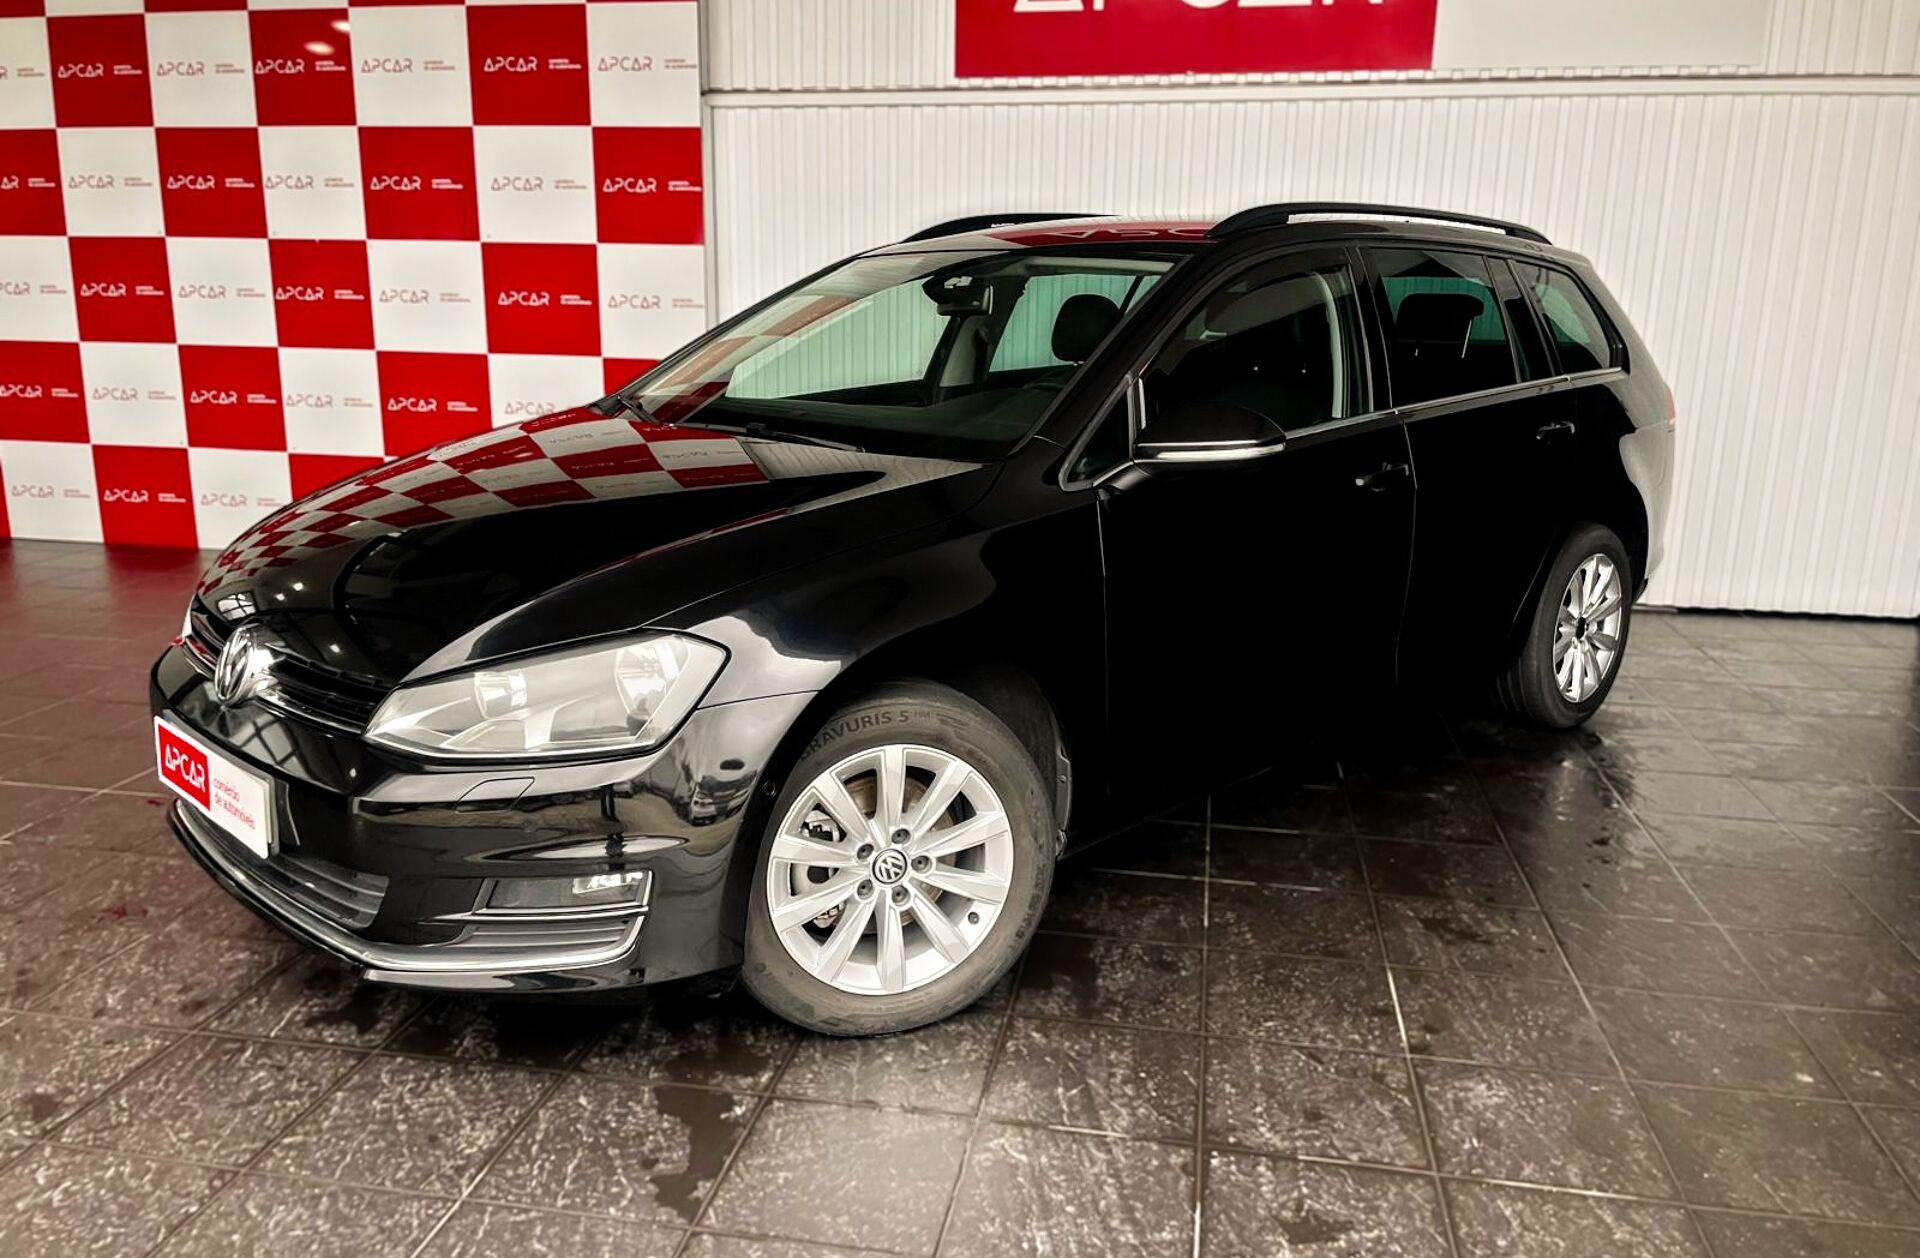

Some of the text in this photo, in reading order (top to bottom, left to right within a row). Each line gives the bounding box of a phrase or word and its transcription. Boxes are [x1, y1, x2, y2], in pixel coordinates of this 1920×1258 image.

[58, 63, 104, 78] APCAR
[156, 61, 205, 76] APCAR
[255, 58, 304, 74] APCAR
[361, 57, 413, 74] APCAR
[484, 56, 537, 72] APCAR
[597, 56, 652, 72] APCAR
[69, 174, 114, 188] APCAR
[167, 174, 215, 189] APCAR
[265, 175, 313, 189] APCAR
[370, 176, 421, 190] APCAR
[491, 177, 543, 191] APCAR
[602, 178, 657, 192] APCAR
[80, 282, 126, 297] APCAR
[178, 284, 226, 299] APCAR
[276, 286, 324, 301] APCAR
[380, 289, 429, 303] APCAR
[498, 292, 550, 306] APCAR
[608, 294, 660, 310] APCAR
[93, 387, 138, 401] APCAR
[191, 390, 237, 405] APCAR
[286, 394, 333, 407] APCAR
[388, 397, 436, 412] APCAR
[505, 400, 556, 415] APCAR
[11, 484, 54, 498] APCAR
[104, 488, 148, 503] APCAR
[201, 493, 247, 507] APCAR
[899, 710, 909, 723] 5
[165, 743, 206, 793] APCAR
